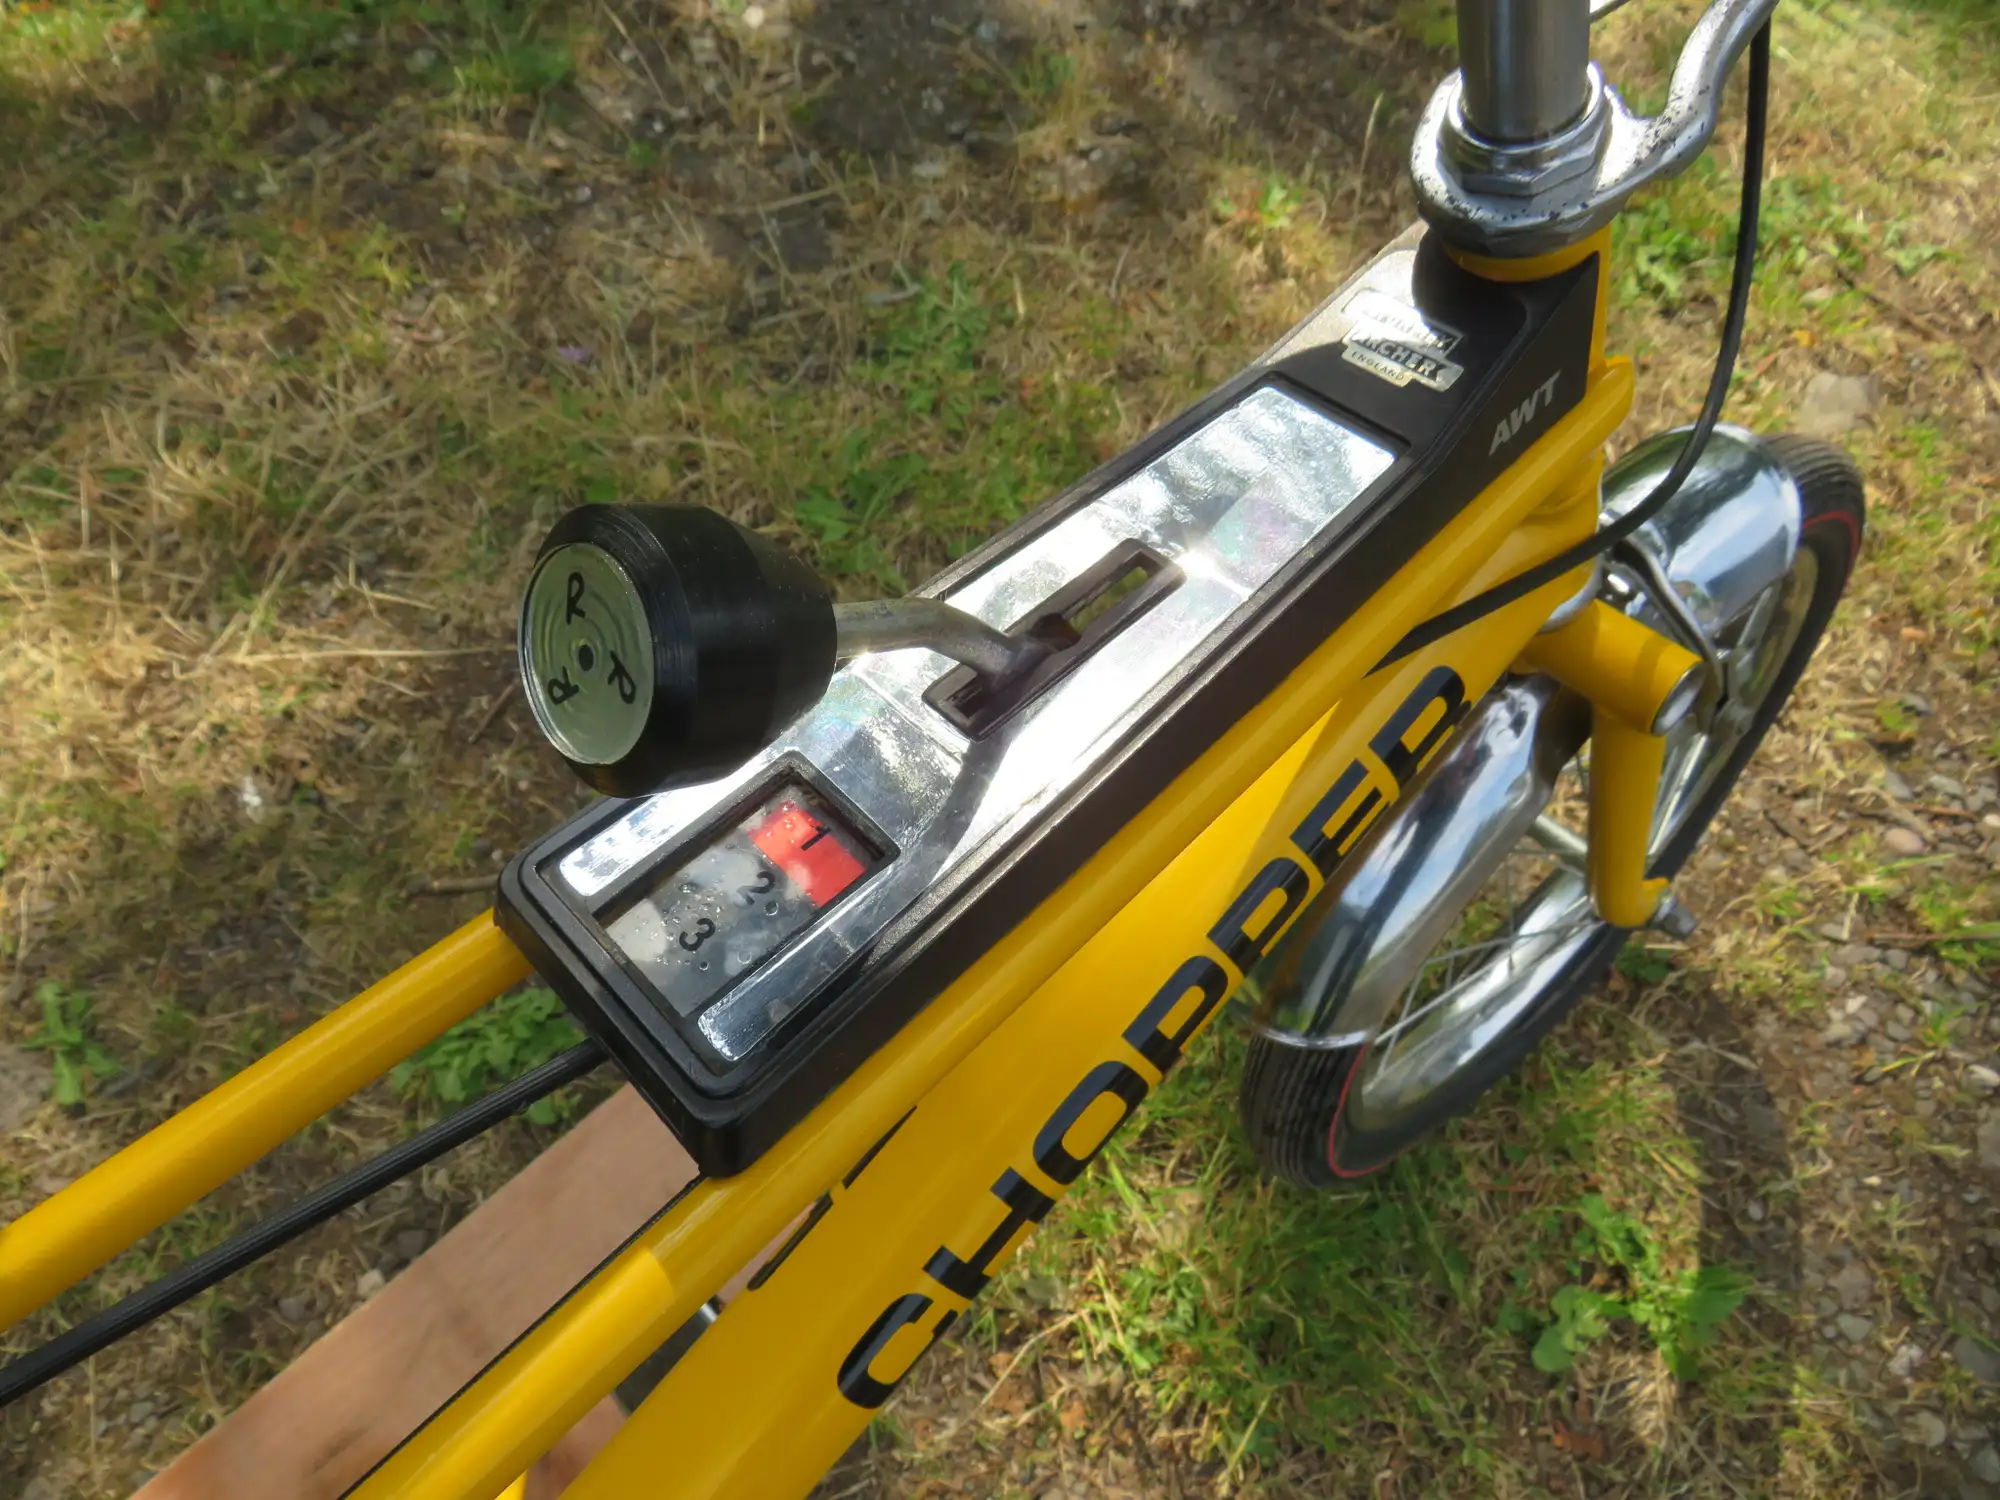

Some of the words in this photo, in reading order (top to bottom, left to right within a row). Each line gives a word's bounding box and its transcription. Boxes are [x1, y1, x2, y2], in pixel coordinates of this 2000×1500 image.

[1351, 351, 1404, 381] ENGLAND
[1488, 370, 1561, 457] AWT
[566, 571, 587, 625] R
[547, 665, 580, 706] R
[801, 824, 831, 851] 1
[737, 870, 776, 906] 2
[679, 917, 716, 951] 3
[837, 664, 1472, 1410] CHOPPER
